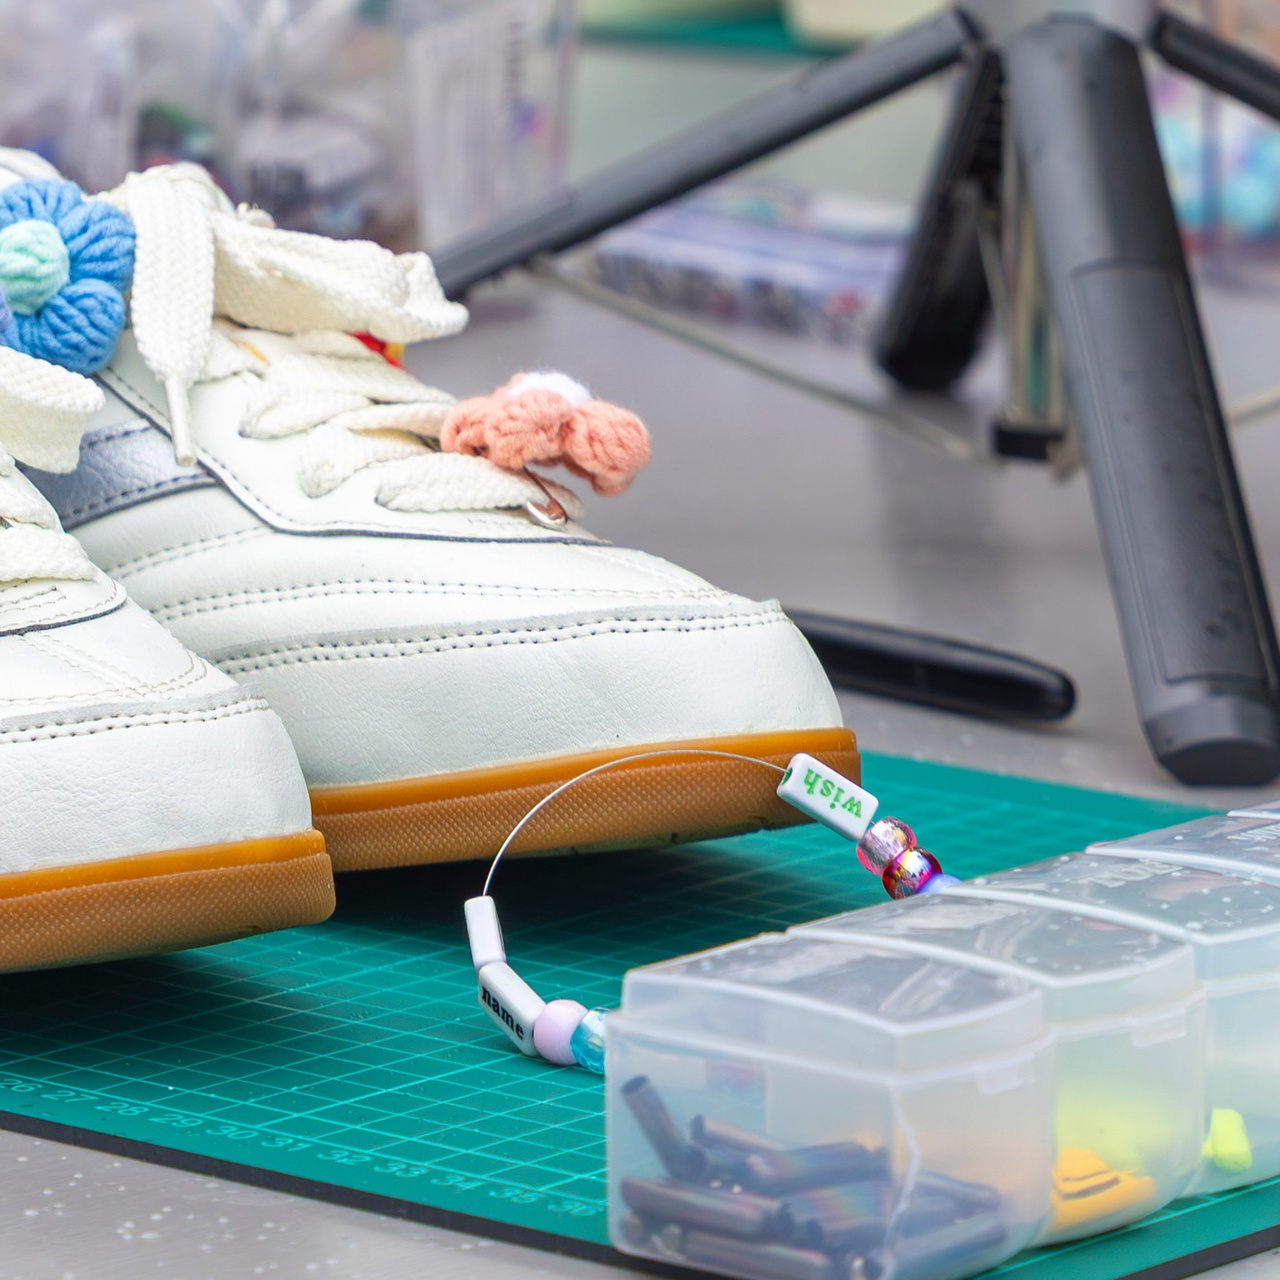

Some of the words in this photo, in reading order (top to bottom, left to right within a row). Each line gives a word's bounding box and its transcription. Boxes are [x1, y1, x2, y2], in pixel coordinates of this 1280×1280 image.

[803, 768, 862, 819] wish
[1077, 861, 1184, 888] TUE
[482, 985, 524, 1041] name
[39, 1090, 99, 1103] 27
[94, 1101, 149, 1116] 28
[147, 1113, 204, 1128] 29
[205, 1125, 259, 1140] 30
[261, 1137, 313, 1151] 31
[316, 1150, 372, 1166] 32
[372, 1162, 428, 1178] 33
[430, 1174, 487, 1190] 34
[488, 1188, 548, 1203] 35
[547, 1201, 606, 1216] 36
